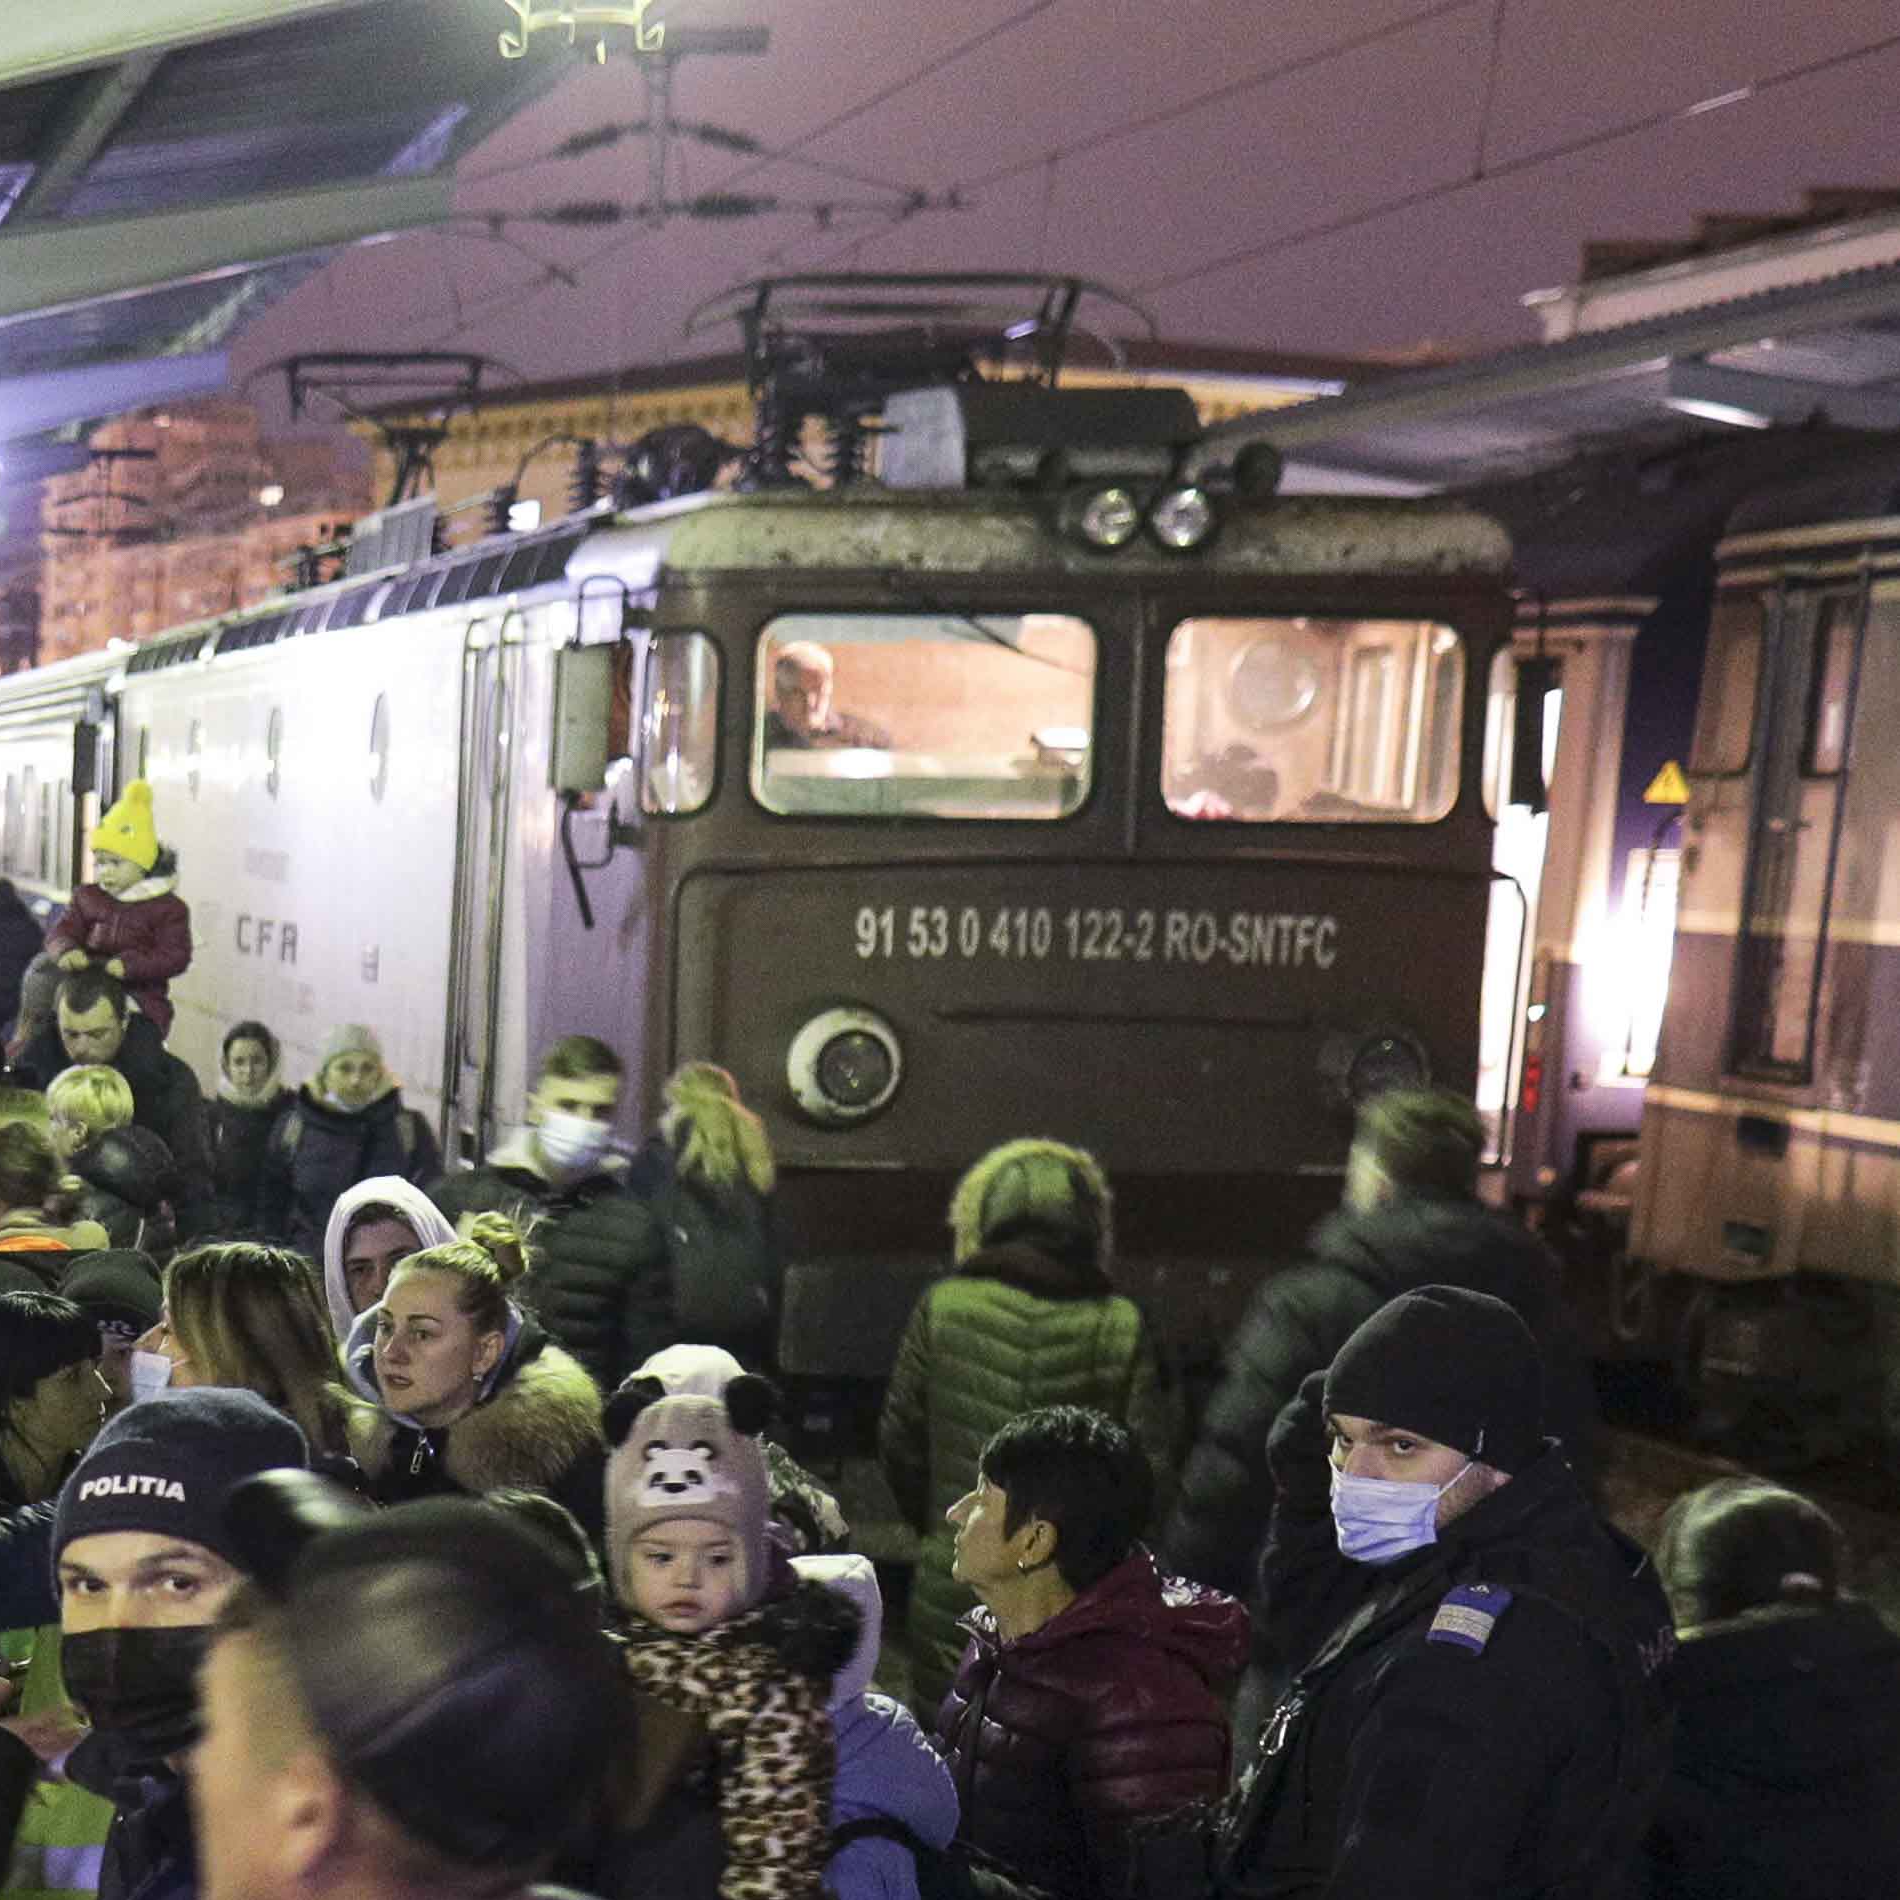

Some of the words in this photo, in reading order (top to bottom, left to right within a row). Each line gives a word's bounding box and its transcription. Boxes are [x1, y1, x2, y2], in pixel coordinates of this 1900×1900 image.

[855, 906, 895, 958] 91
[907, 905, 949, 958] 53
[959, 905, 981, 958] 0
[989, 906, 1051, 958] 410
[1065, 908, 1154, 959] 122-2
[1164, 908, 1337, 968] RO-SNTFC
[79, 1475, 185, 1501] POLITIA
